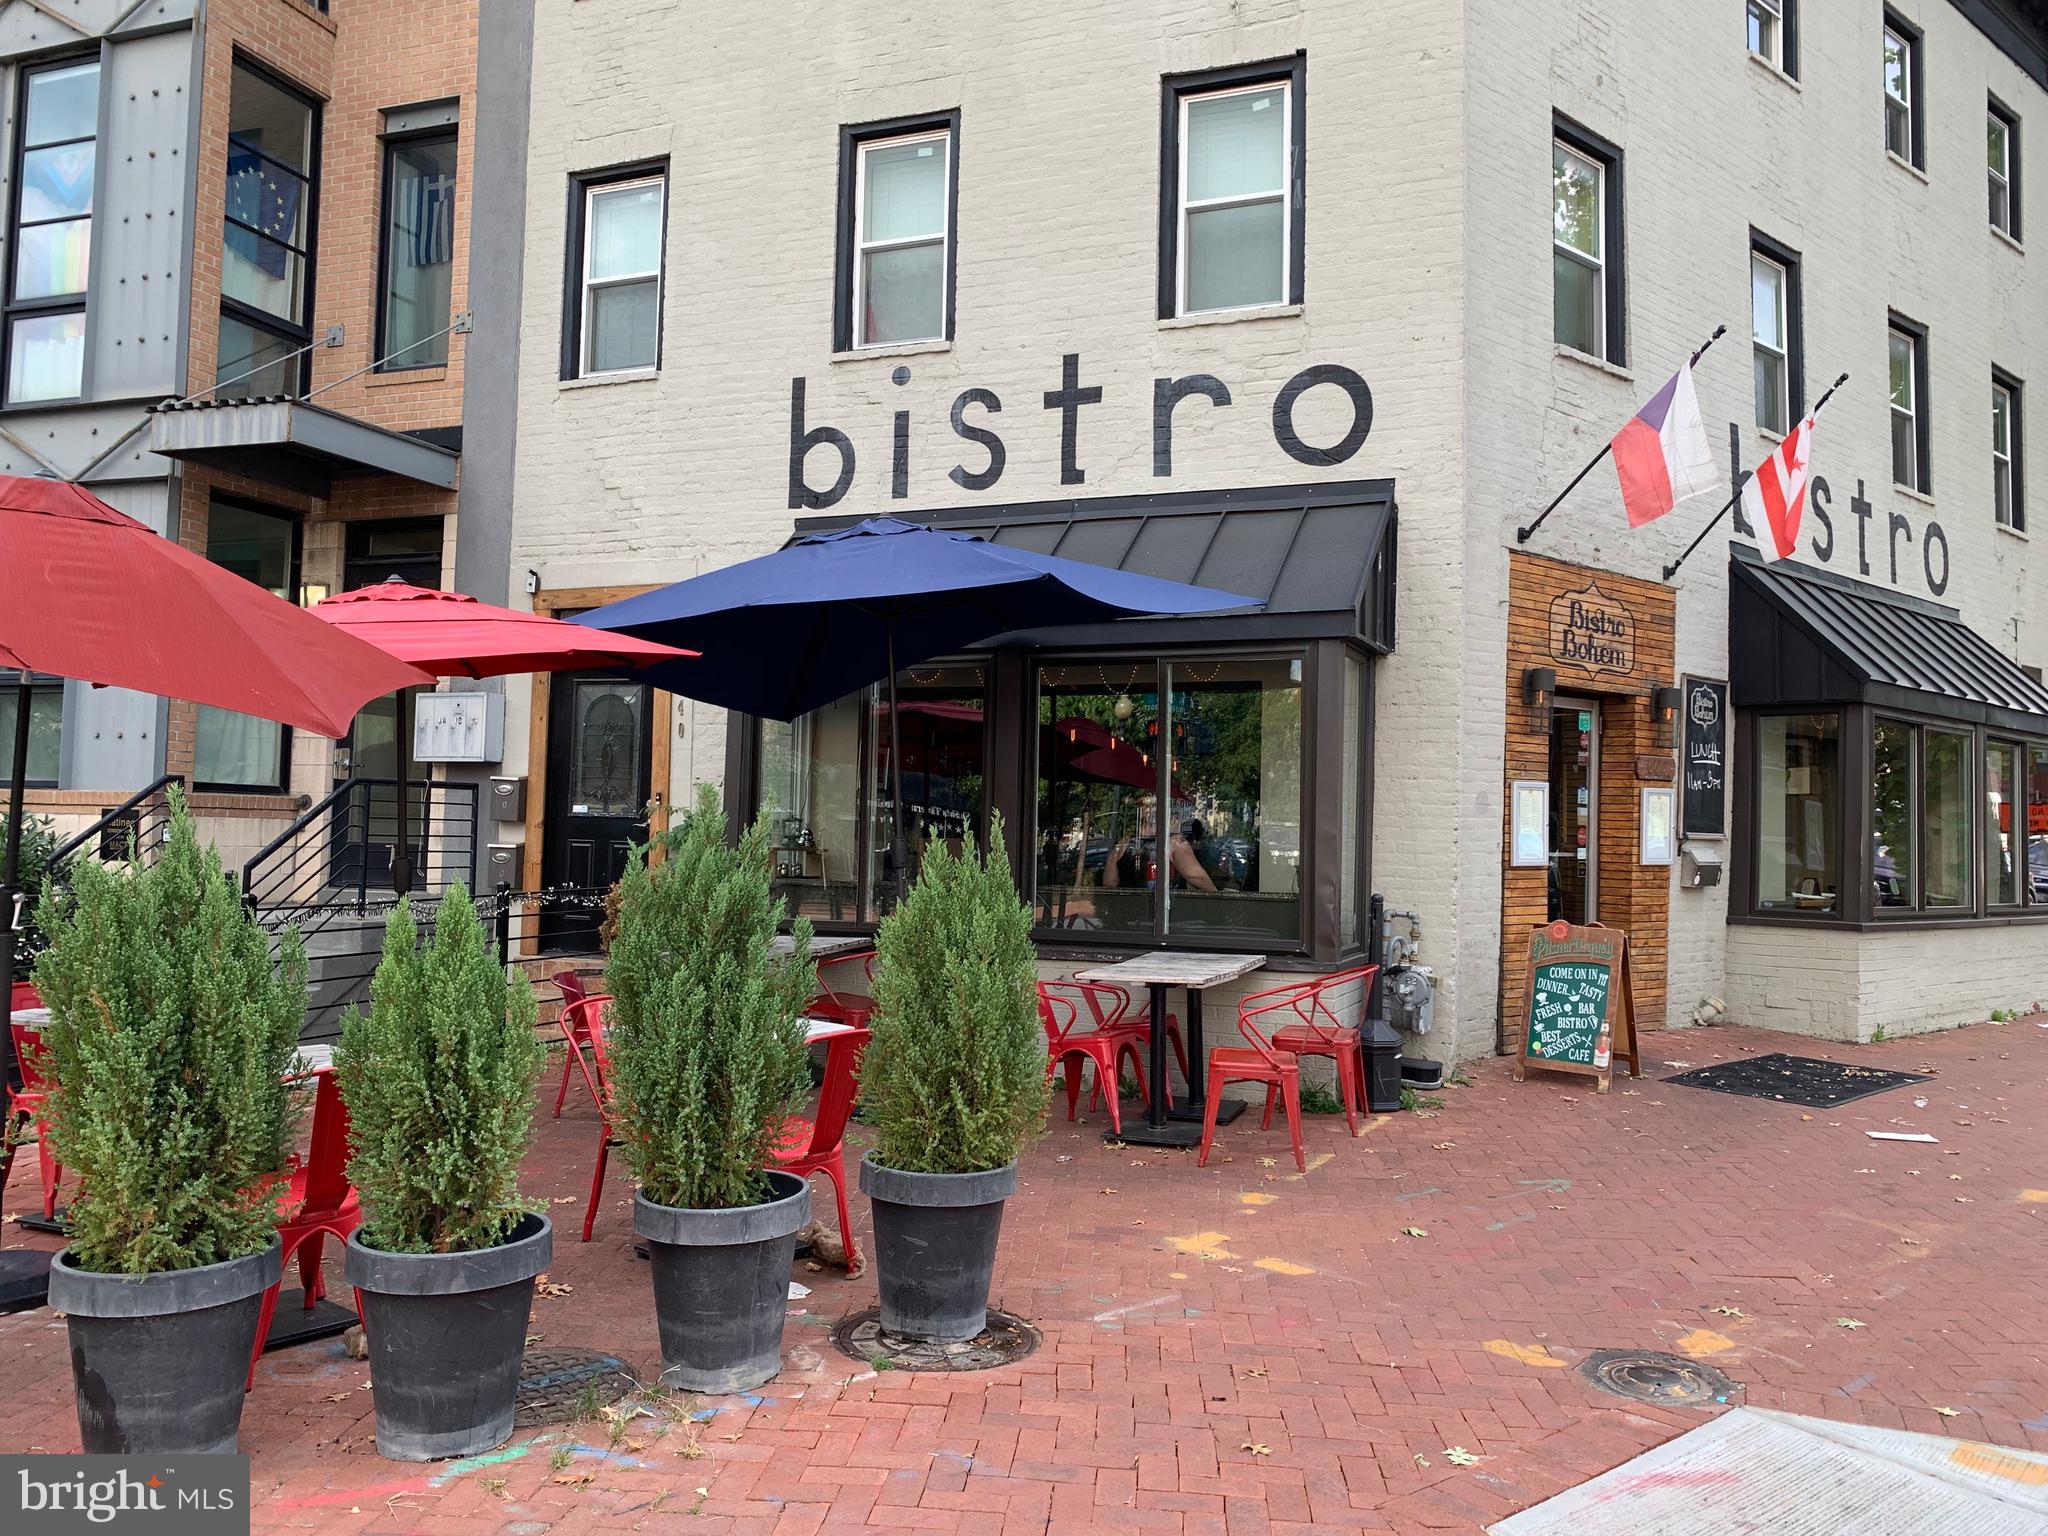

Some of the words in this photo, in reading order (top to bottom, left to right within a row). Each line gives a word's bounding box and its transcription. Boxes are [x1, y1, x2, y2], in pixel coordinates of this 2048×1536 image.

[788, 353, 1373, 509] bistro
[1729, 421, 1949, 597] bstro
[1568, 601, 1625, 637] Bistro
[1691, 741, 1721, 762] LUNCH
[1532, 934, 1573, 963] Pilsner
[1549, 967, 1573, 979] COME
[1574, 968, 1587, 979] ON
[1588, 968, 1598, 979] IN
[1536, 977, 1571, 996] DINNER
[1578, 982, 1605, 1002] TASTY
[1535, 1002, 1562, 1020] FRESH
[1578, 1002, 1595, 1014] BAR
[1557, 1017, 1588, 1029] BISTRO
[1541, 1030, 1561, 1043] BEST
[1542, 1032, 1581, 1058] DESSERTS
[1568, 1048, 1590, 1061] CAFE
